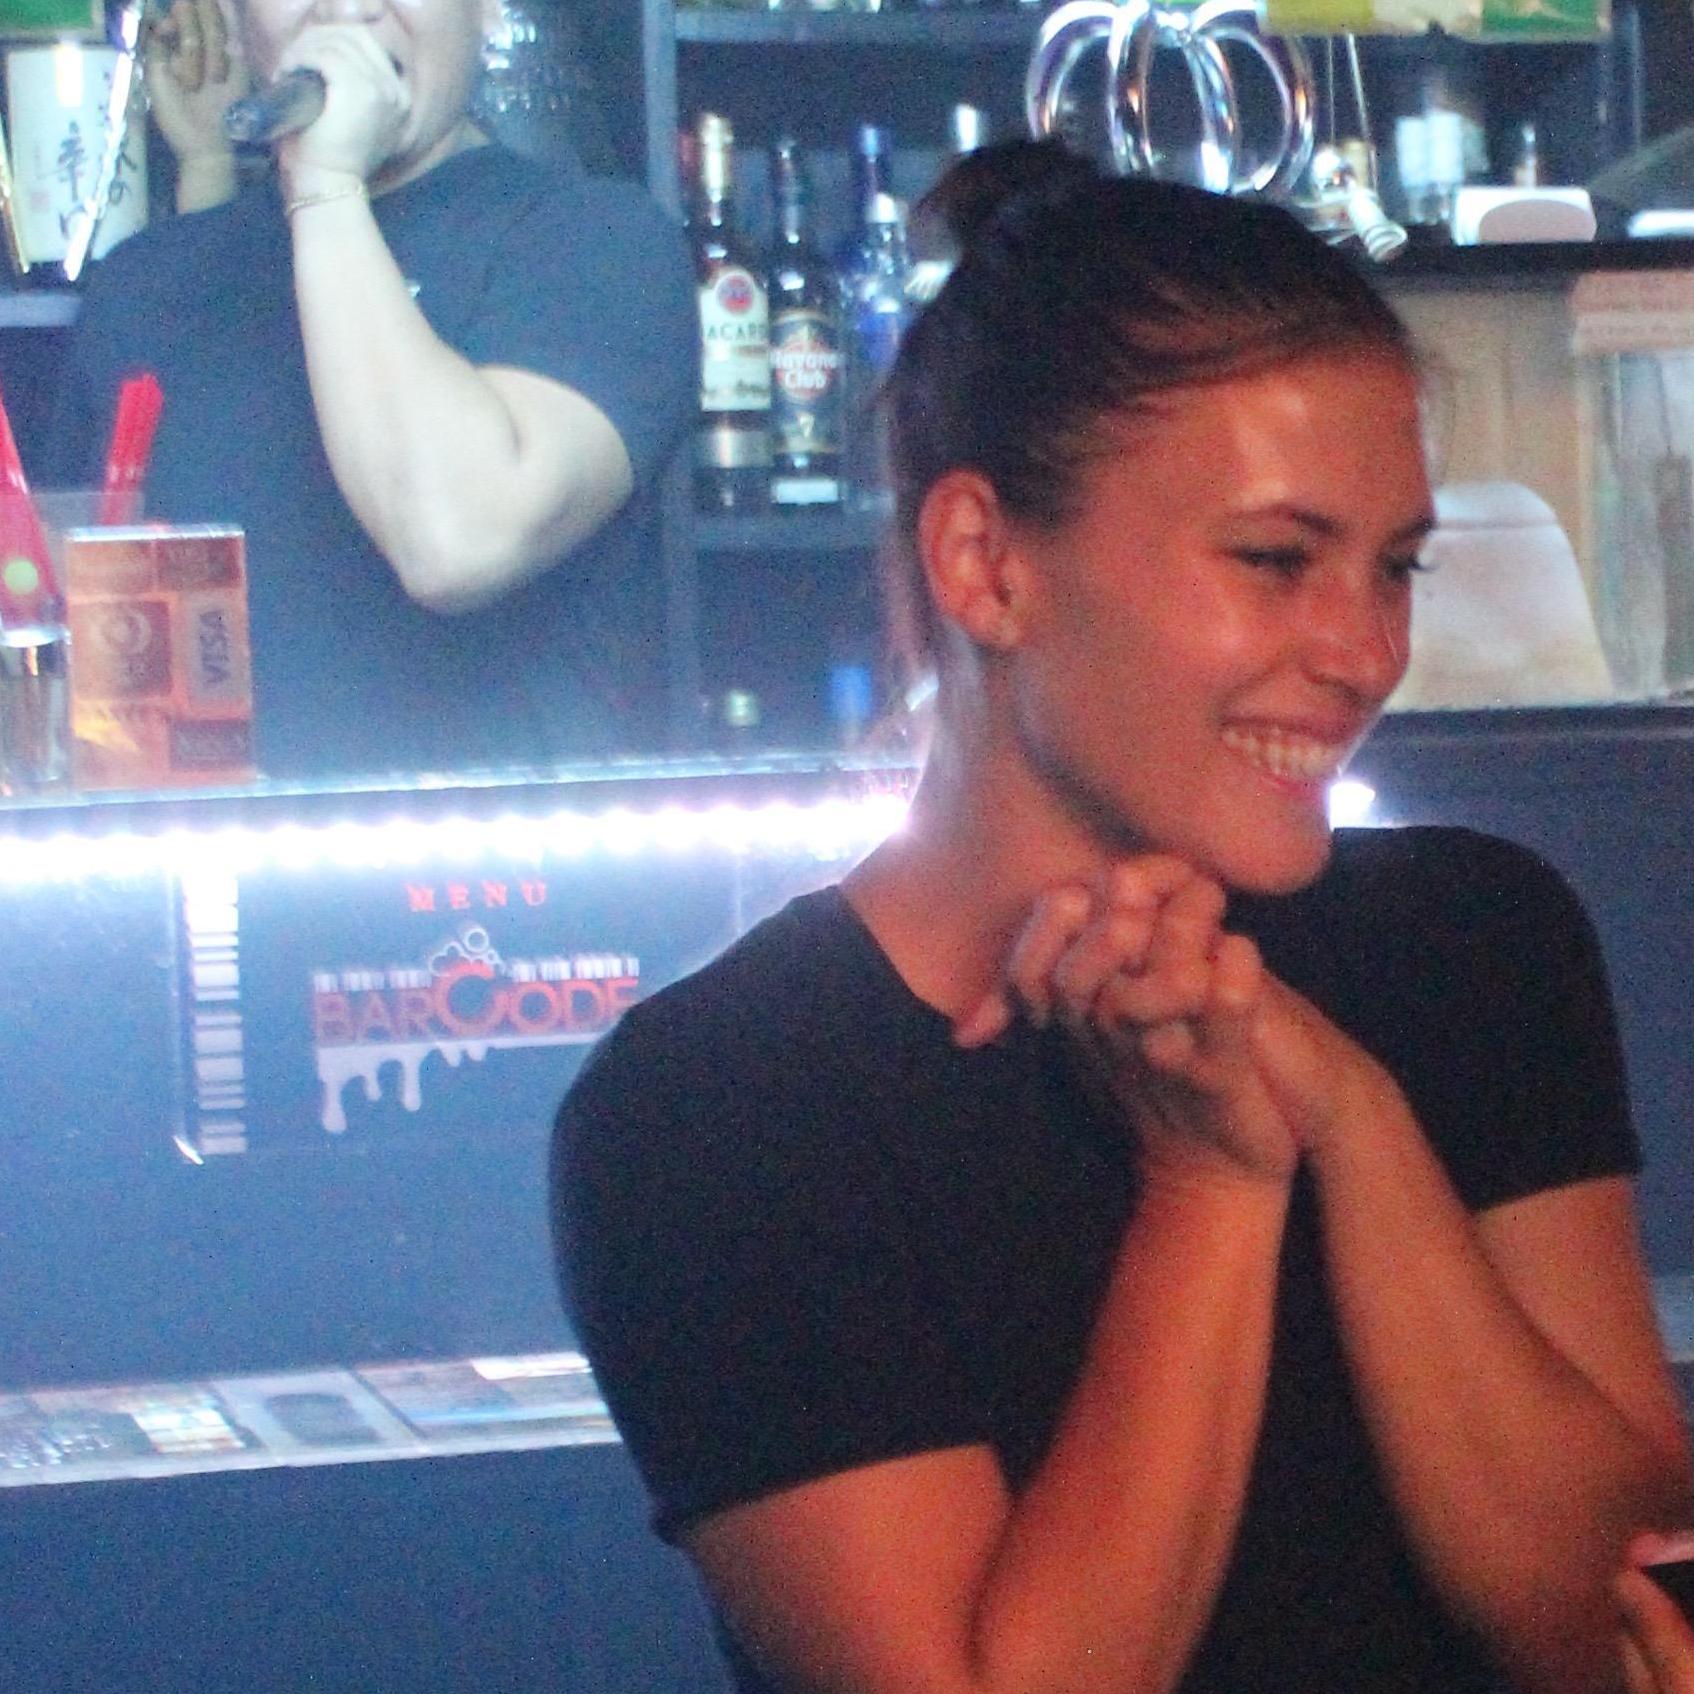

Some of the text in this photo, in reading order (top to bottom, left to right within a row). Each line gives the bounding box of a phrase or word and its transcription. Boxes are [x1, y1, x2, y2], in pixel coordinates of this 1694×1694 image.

[785, 371, 827, 389] Club
[199, 609, 232, 689] VISA
[405, 879, 547, 912] MENU
